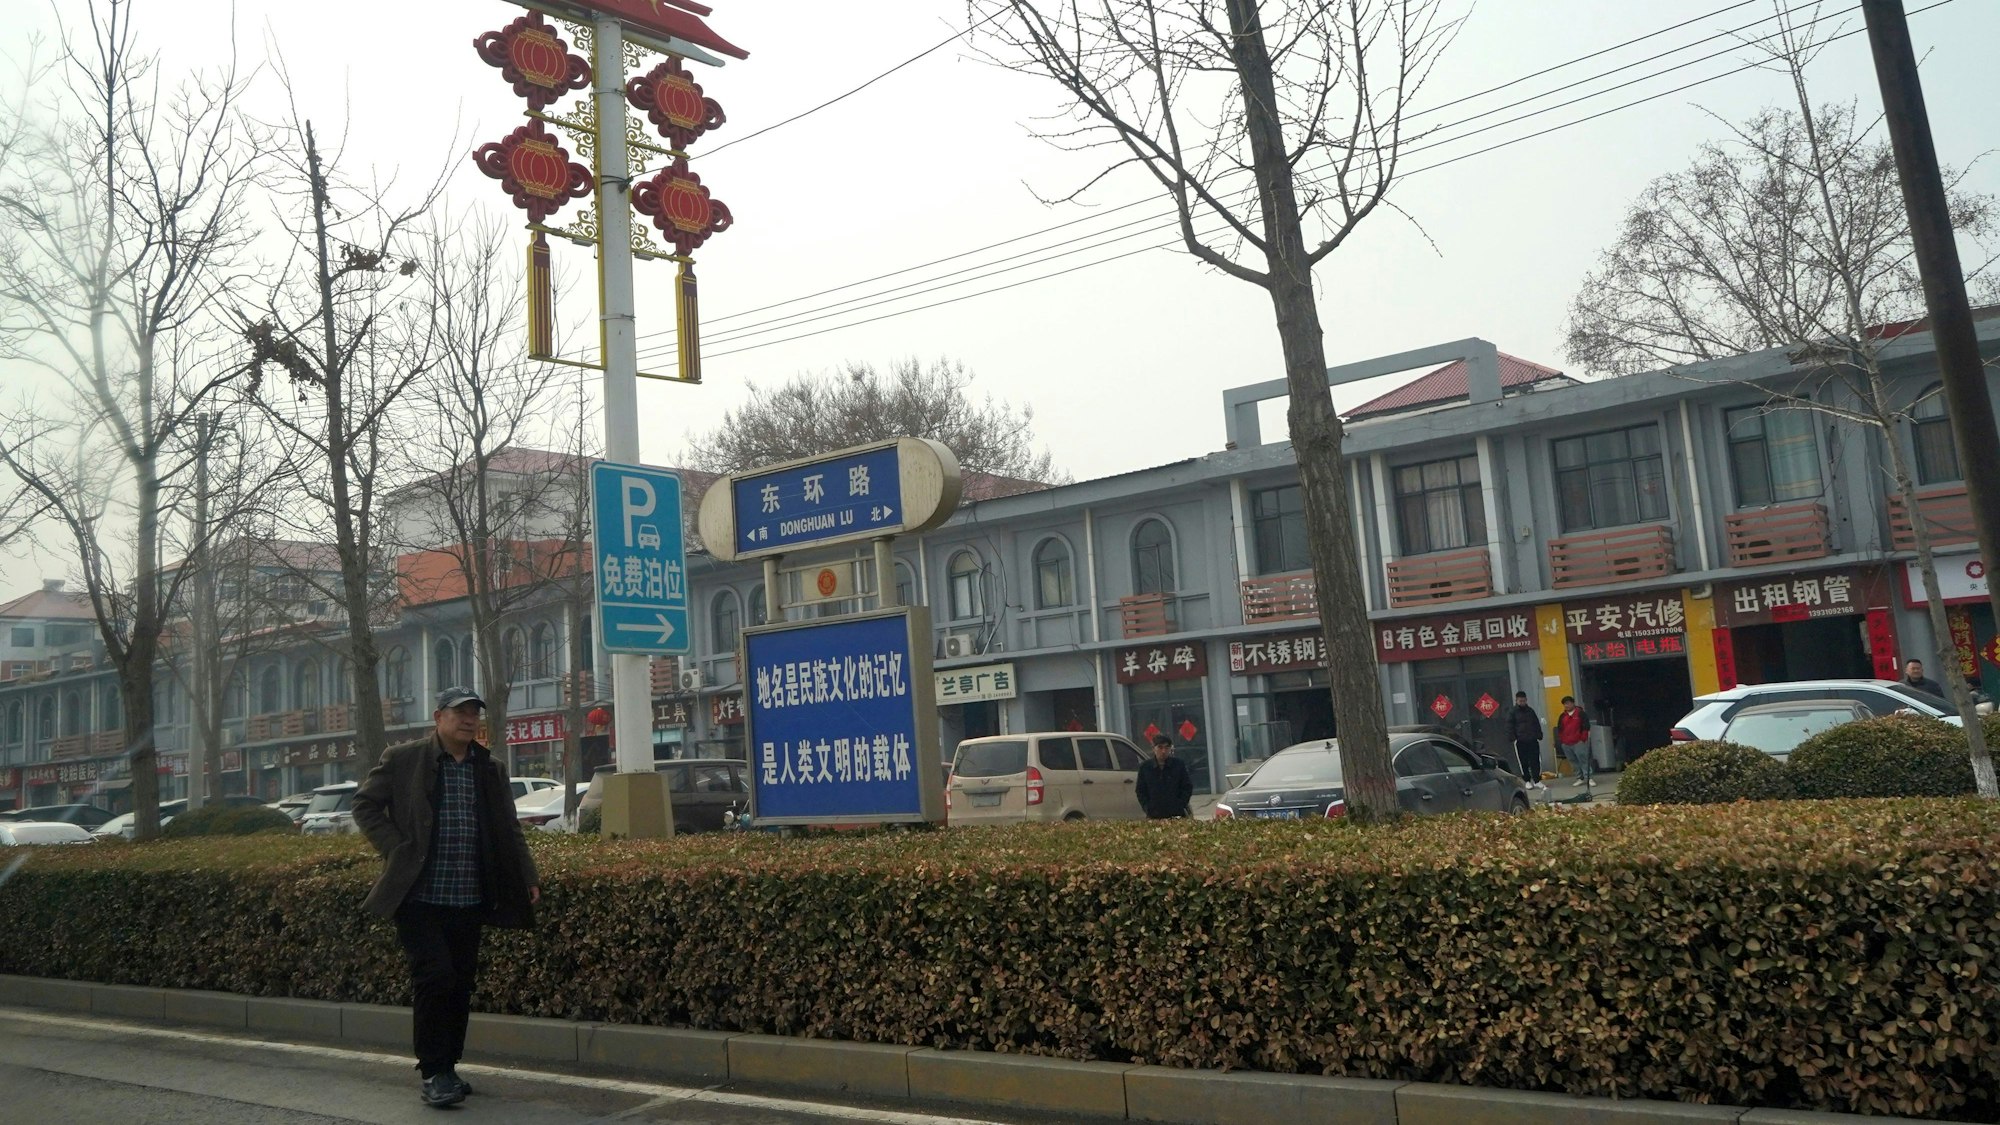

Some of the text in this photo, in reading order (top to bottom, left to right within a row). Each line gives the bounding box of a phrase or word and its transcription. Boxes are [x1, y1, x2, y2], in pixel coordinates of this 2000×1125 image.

[761, 464, 870, 513] 东环路
[621, 476, 656, 547] P
[780, 508, 854, 536] DONGHUAN LU
[871, 507, 881, 522] 北
[758, 526, 768, 540] 南
[603, 553, 682, 599] 免费泊位
[1734, 575, 1850, 613] 出租钢管
[1566, 599, 1684, 635] 平安汽修
[1808, 606, 1855, 617] 13931092168
[1396, 615, 1529, 649] 有色金属回收
[1584, 635, 1683, 660] 补胎 电瓶
[1122, 645, 1196, 677] 羊杂碎
[1231, 643, 1243, 669] 新创
[756, 651, 905, 709] 地名是民族文化的记忆
[942, 671, 1009, 696] 兰亭广告
[59, 762, 97, 782] 轮胎医院
[761, 733, 911, 785] 是人类文明的载体
